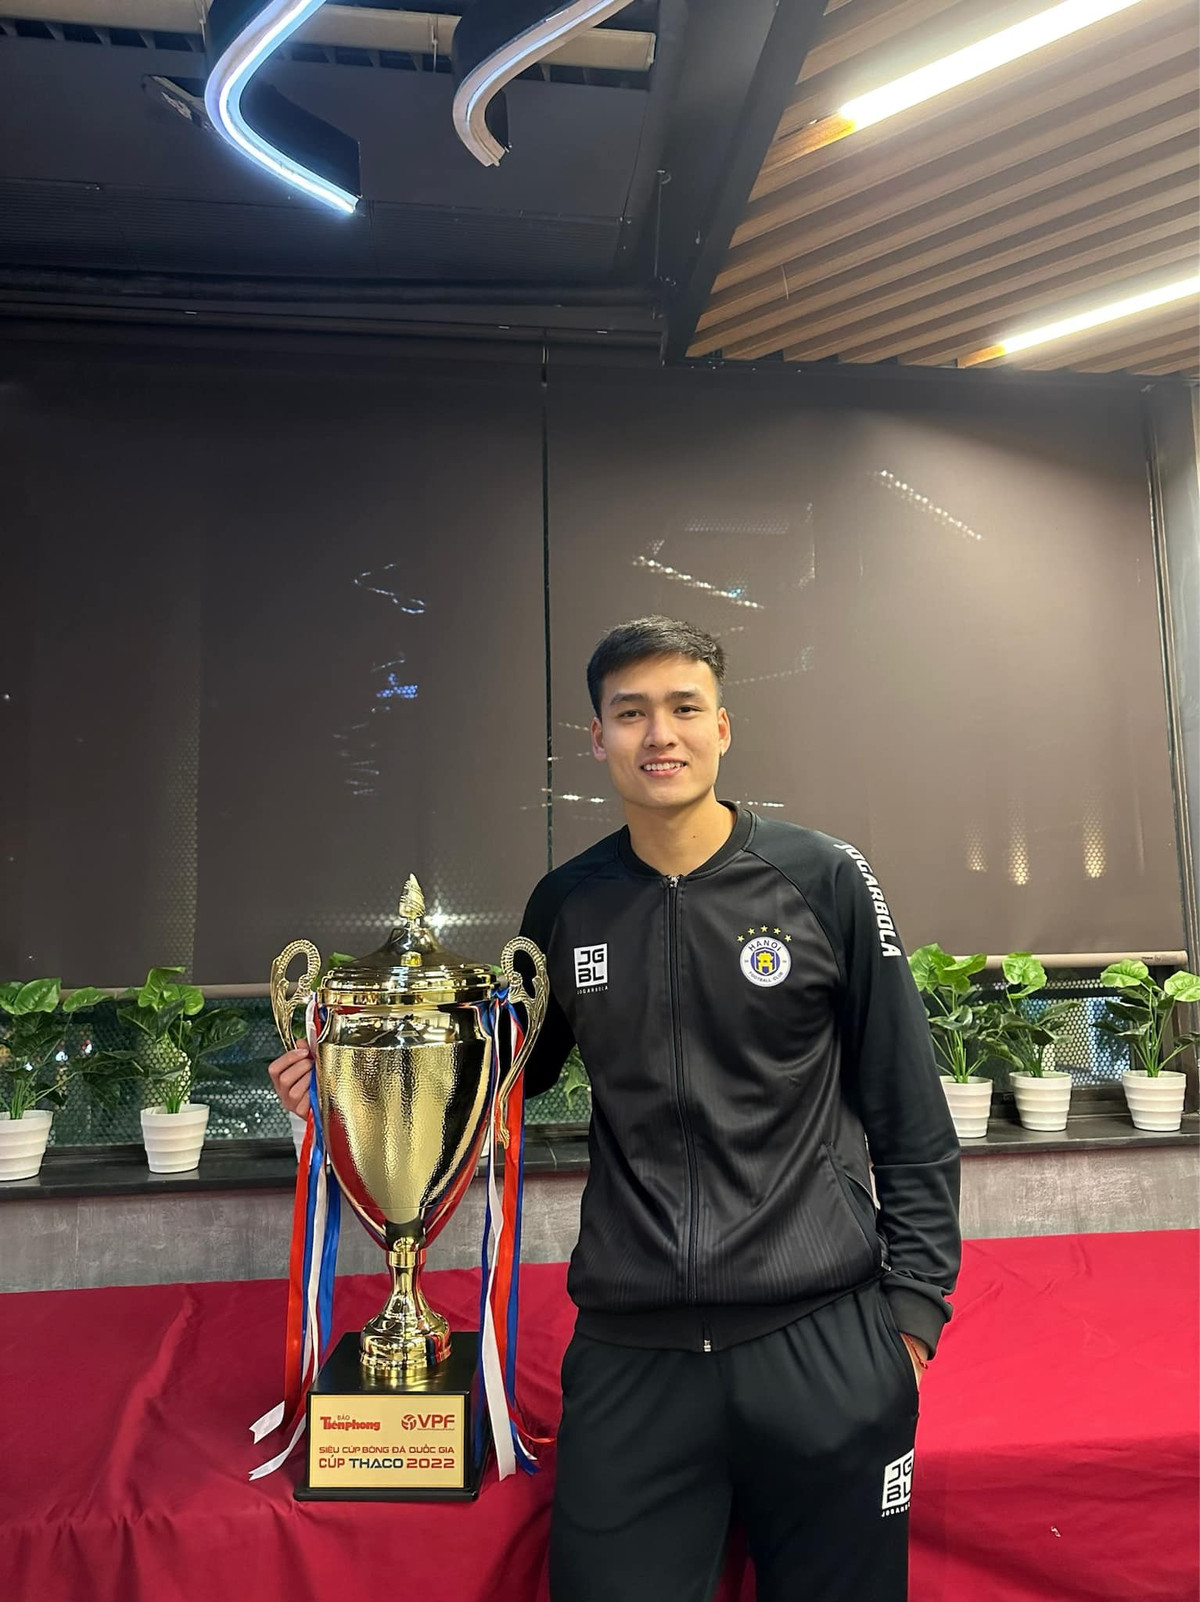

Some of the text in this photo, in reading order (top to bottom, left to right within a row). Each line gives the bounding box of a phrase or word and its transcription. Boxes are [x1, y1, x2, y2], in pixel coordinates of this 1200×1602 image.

[833, 843, 902, 957] JOGARBOLA
[748, 940, 781, 951] HANOI
[749, 971, 784, 983] FOOTBALL CLUB
[417, 1414, 456, 1428] VPF
[319, 1445, 340, 1453] SIÊU
[342, 1445, 361, 1453] CÚP
[438, 1446, 455, 1454] GIA
[319, 1454, 456, 1469] CÚP THACO 2022
